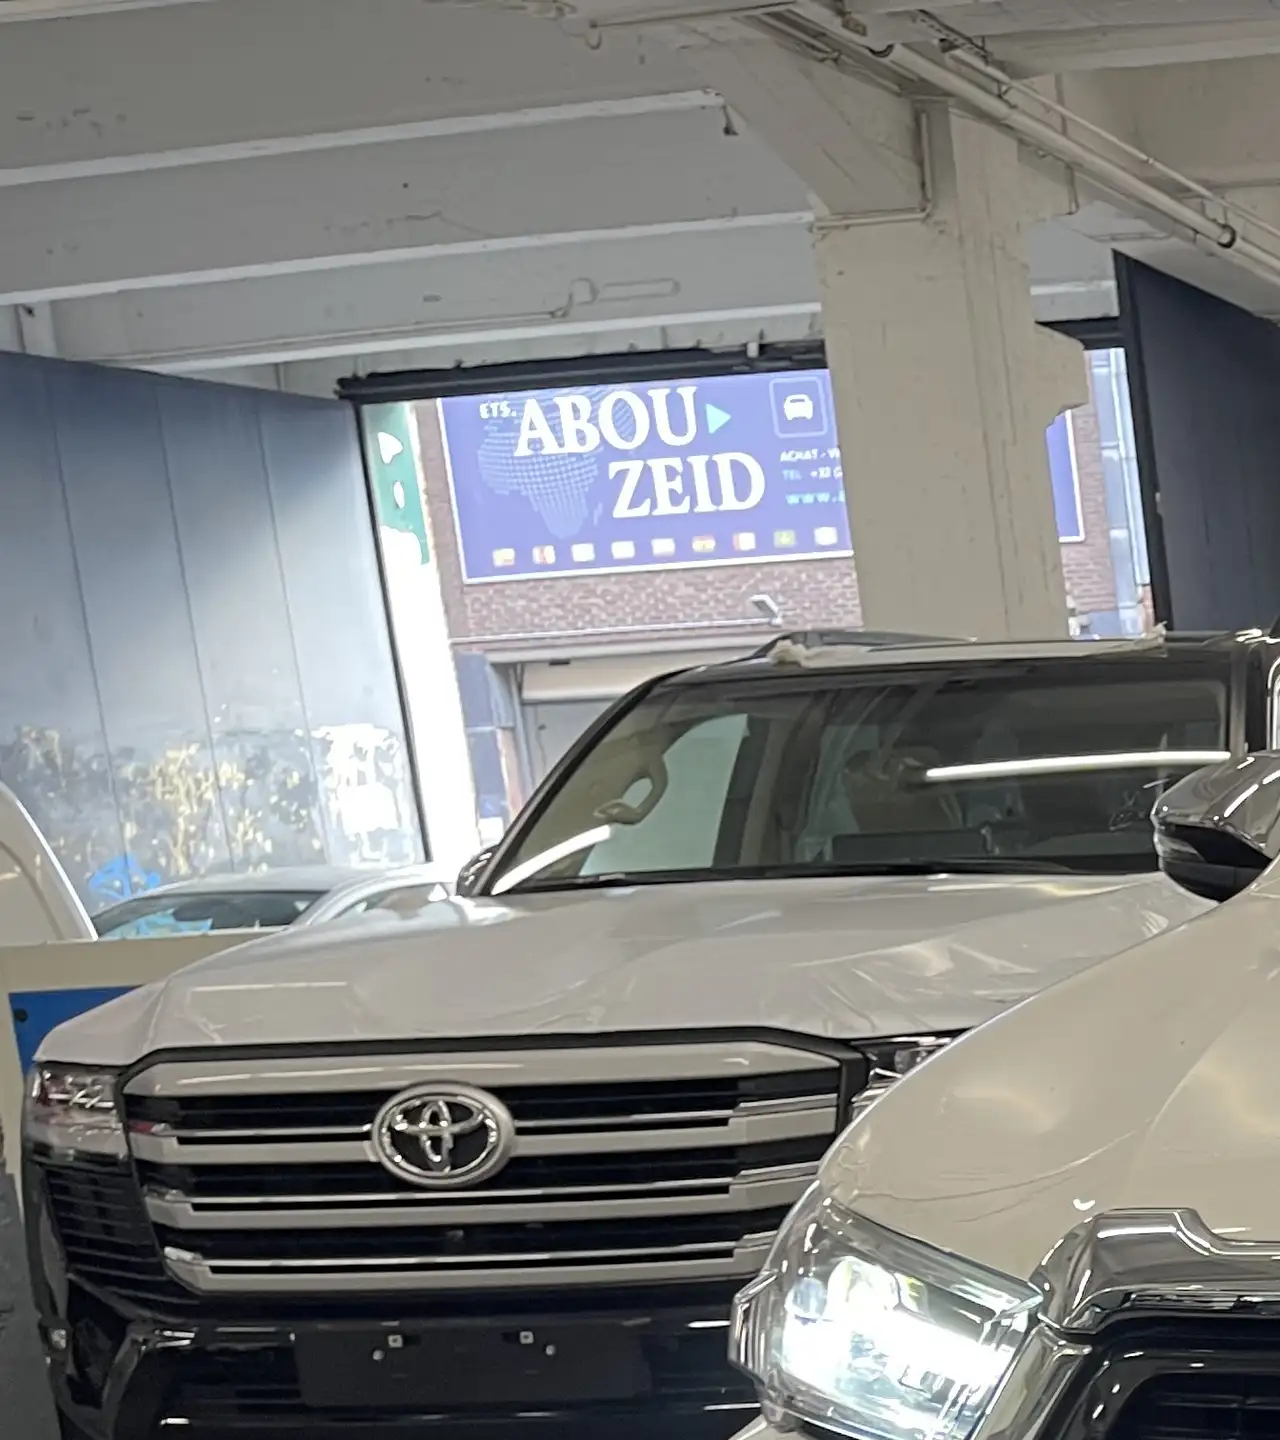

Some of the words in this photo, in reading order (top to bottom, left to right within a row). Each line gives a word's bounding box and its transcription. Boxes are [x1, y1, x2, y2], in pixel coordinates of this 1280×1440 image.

[479, 401, 517, 419] ETS.
[513, 386, 698, 457] ABOU
[608, 452, 766, 518] ZEID
